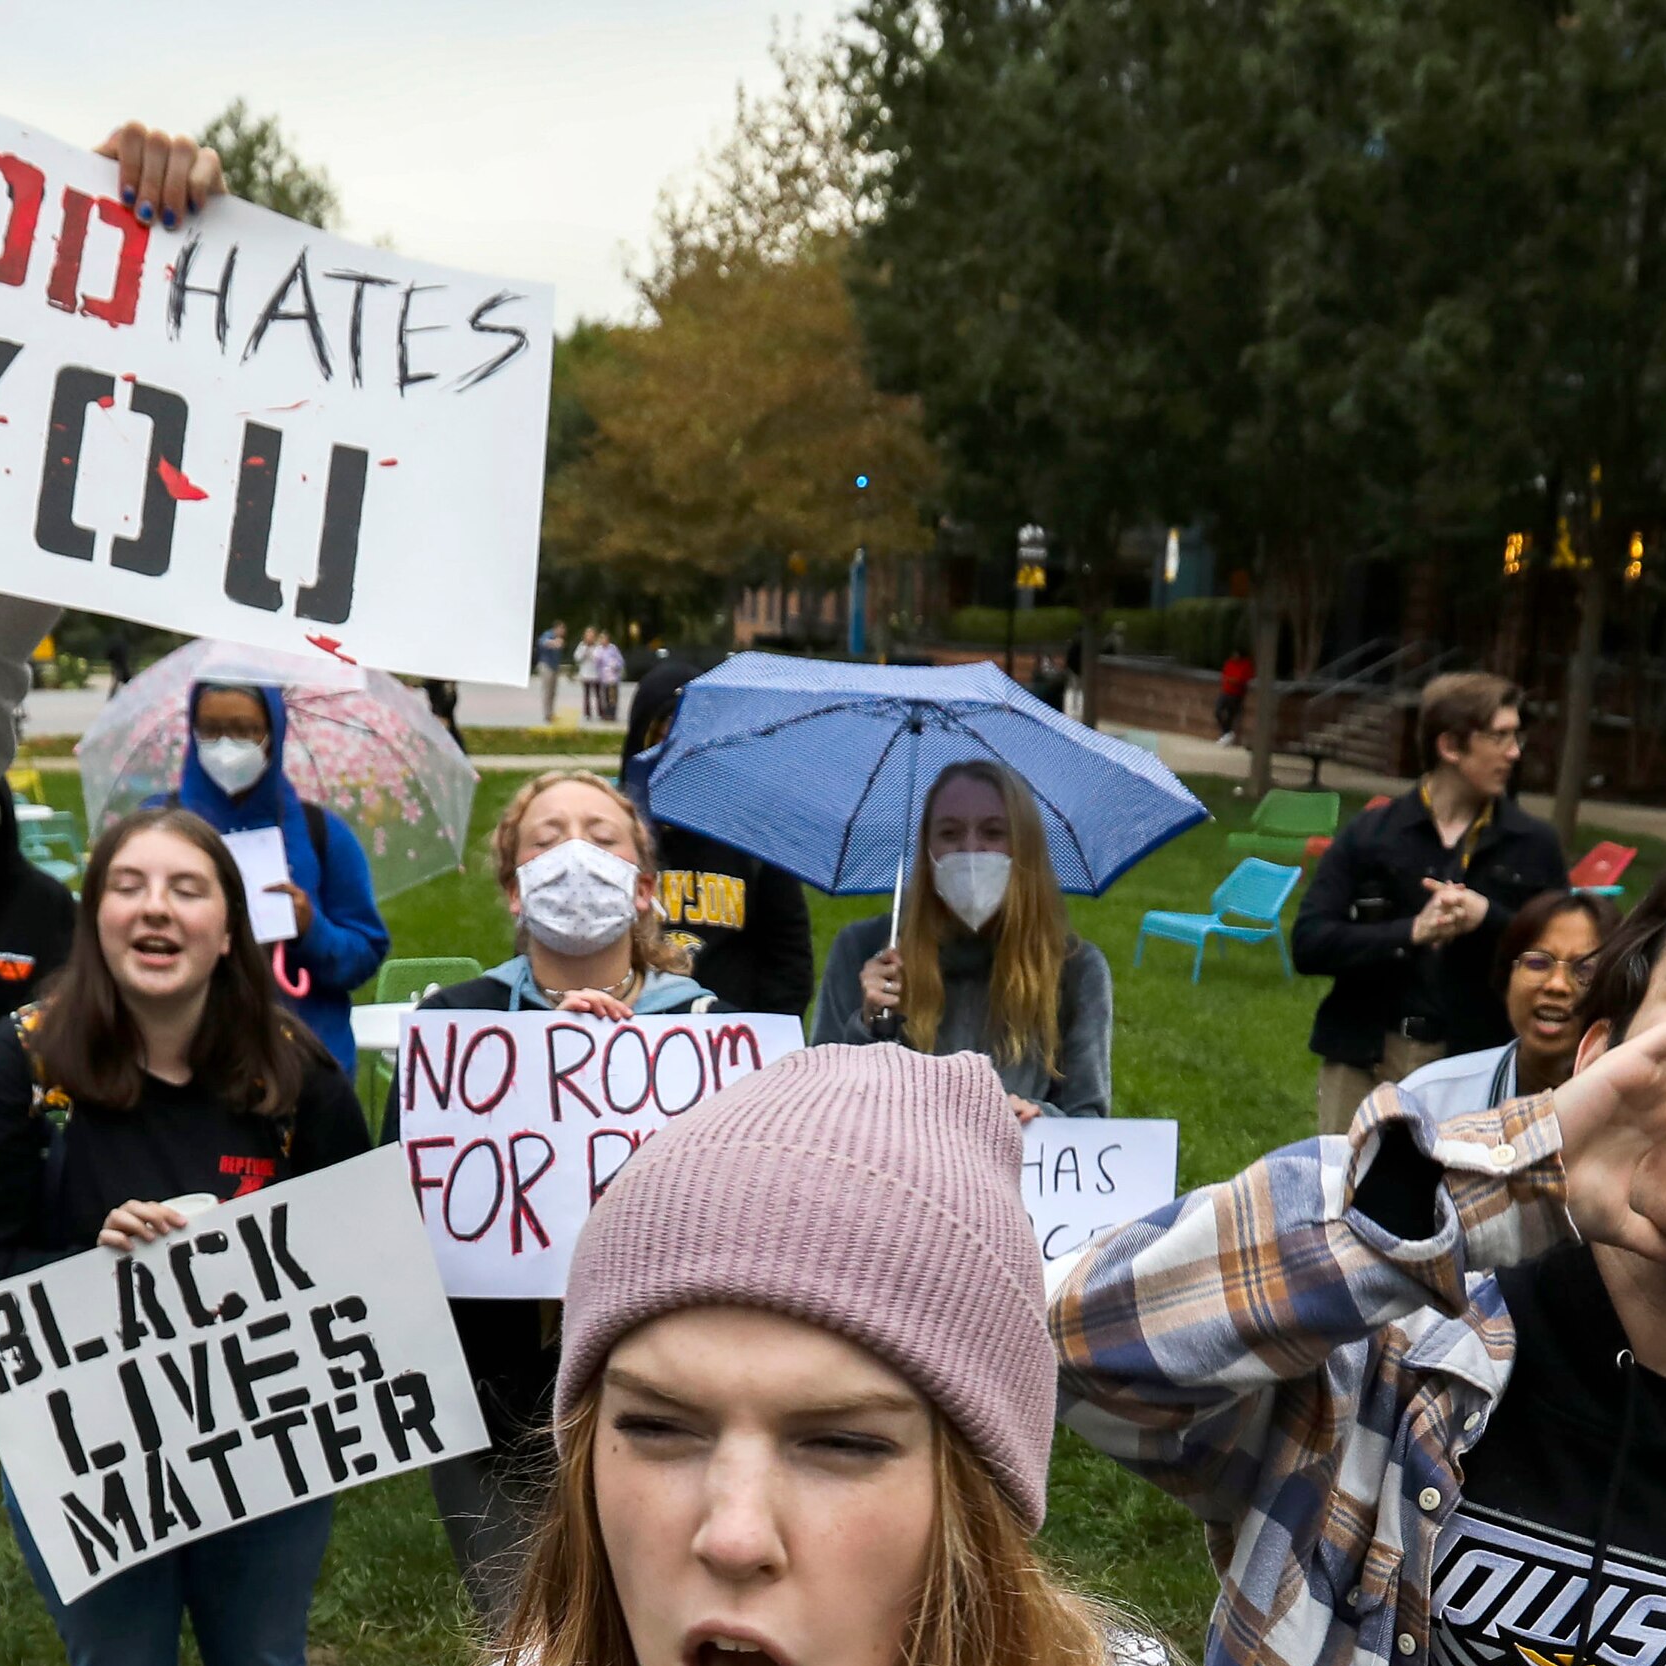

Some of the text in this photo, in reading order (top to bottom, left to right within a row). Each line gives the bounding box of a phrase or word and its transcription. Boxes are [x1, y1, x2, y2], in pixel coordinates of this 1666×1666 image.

[164, 229, 531, 398] HATES
[401, 1022, 517, 1116] NO
[406, 1129, 556, 1256] FOR
[47, 1295, 383, 1476] LIVES
[60, 1370, 445, 1577] MATTER
